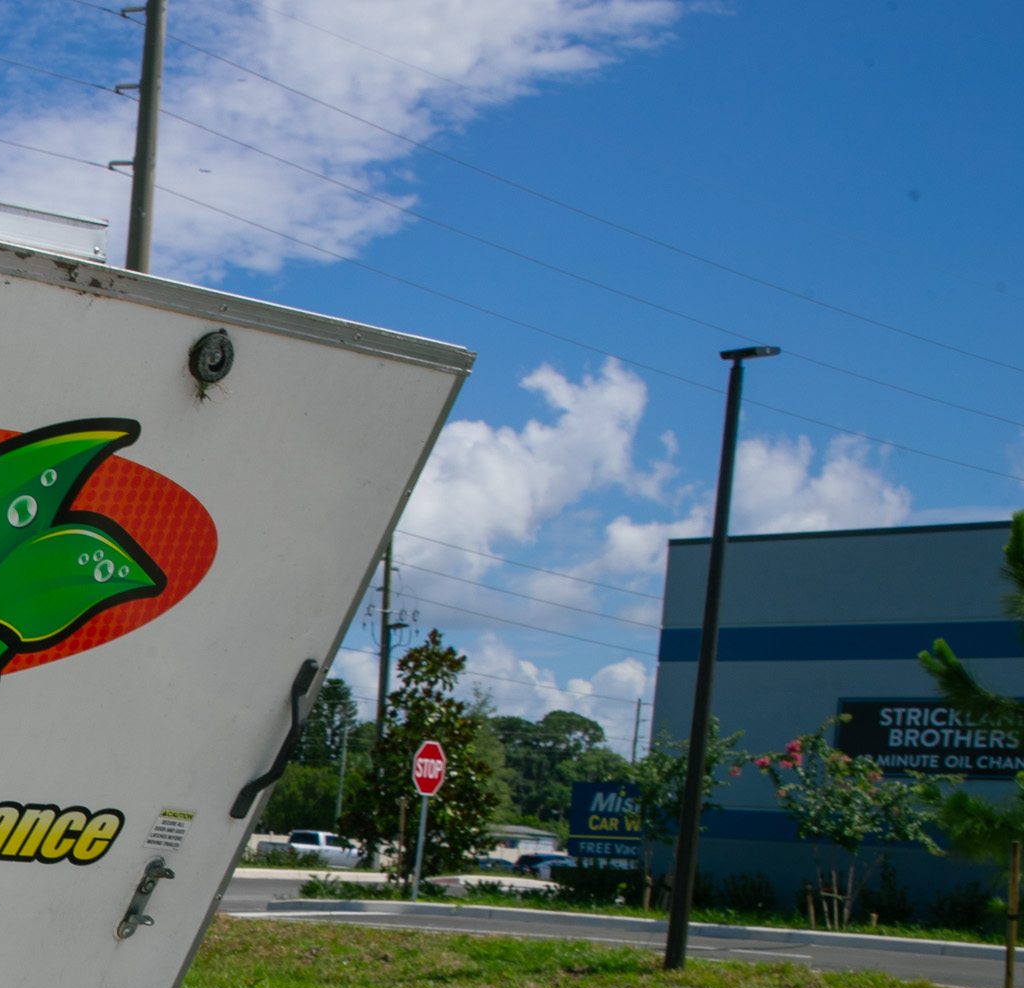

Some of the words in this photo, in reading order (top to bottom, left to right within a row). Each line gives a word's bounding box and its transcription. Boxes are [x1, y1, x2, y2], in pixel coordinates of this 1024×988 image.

[888, 728, 1021, 749] BROTHERS
[415, 757, 443, 780] STOP
[876, 754, 940, 768] MINUTE
[943, 755, 974, 769] OIL
[588, 814, 619, 831] CAR
[578, 841, 613, 855] FREE
[614, 842, 641, 856] Vac
